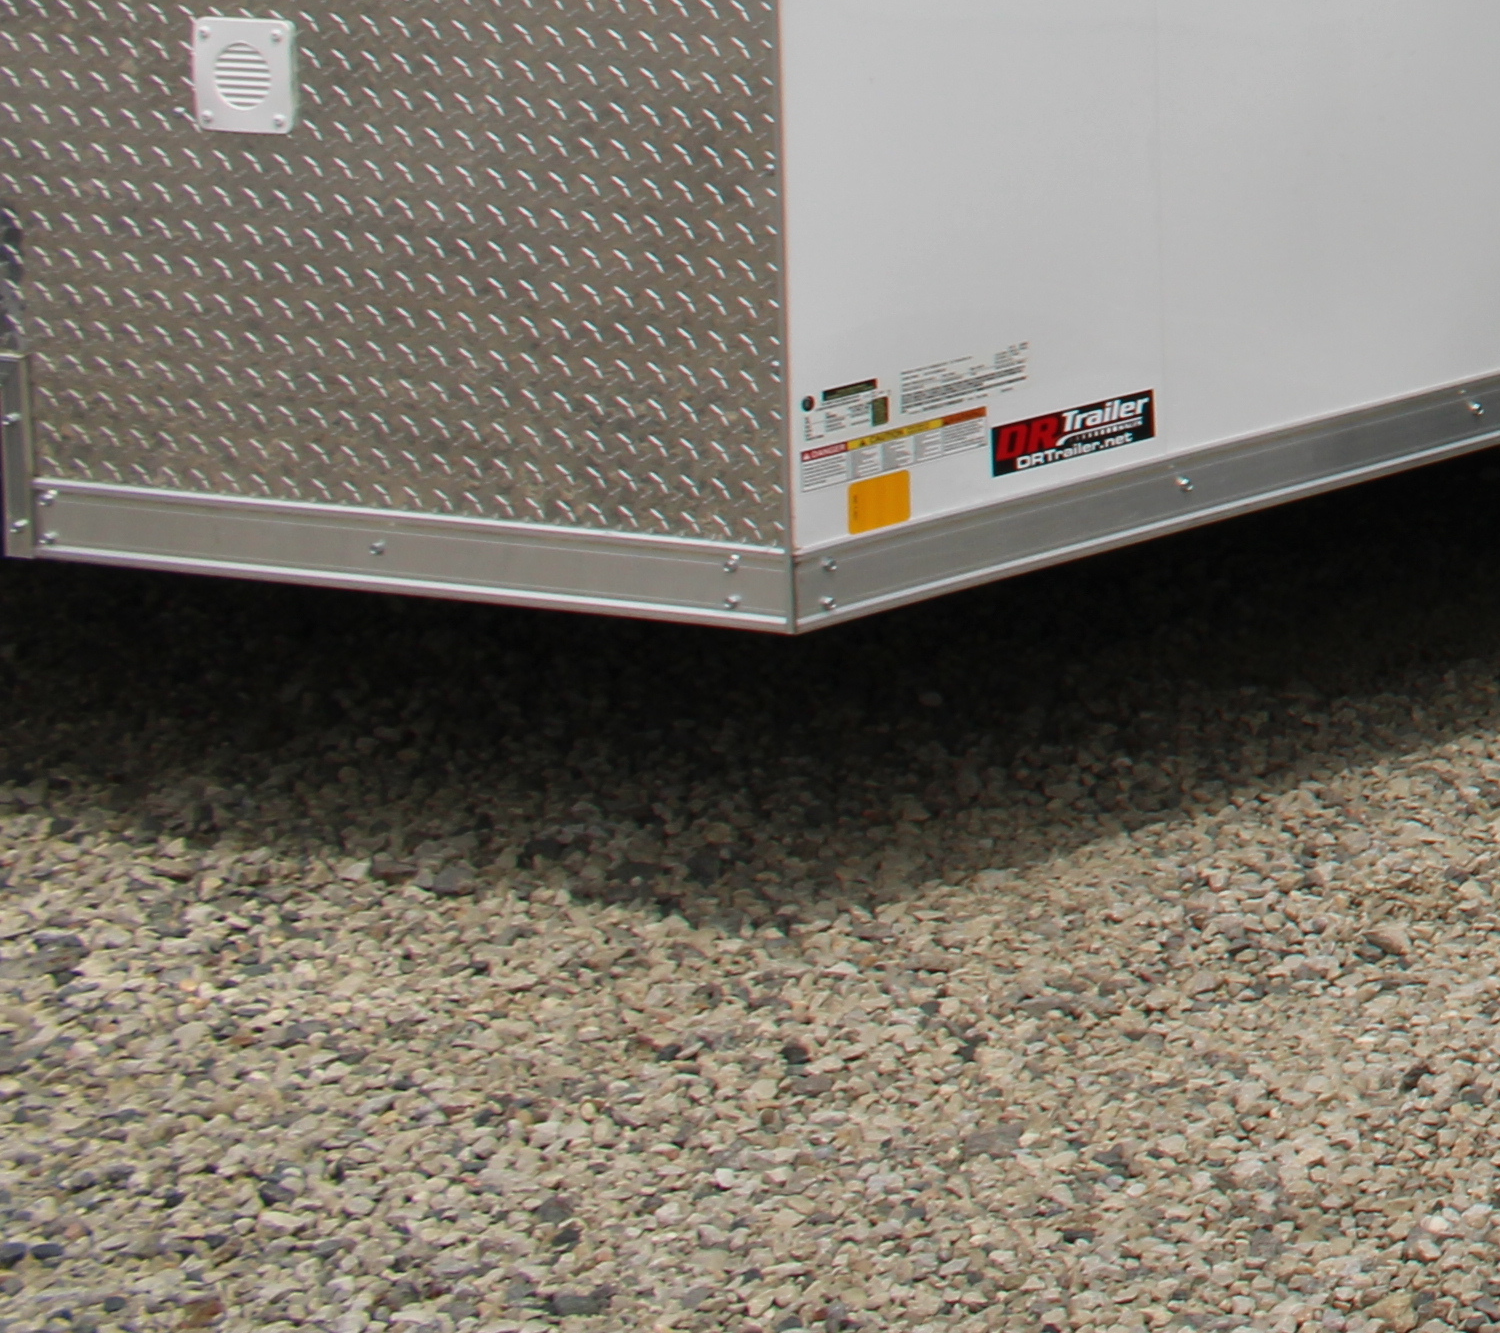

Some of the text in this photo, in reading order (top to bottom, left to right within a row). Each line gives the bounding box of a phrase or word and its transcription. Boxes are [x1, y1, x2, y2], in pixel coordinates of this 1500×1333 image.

[1061, 396, 1150, 433] Trailer
[811, 442, 847, 460] DANGER
[995, 416, 1060, 462] DR
[1016, 430, 1134, 470] DRTrailer.net
